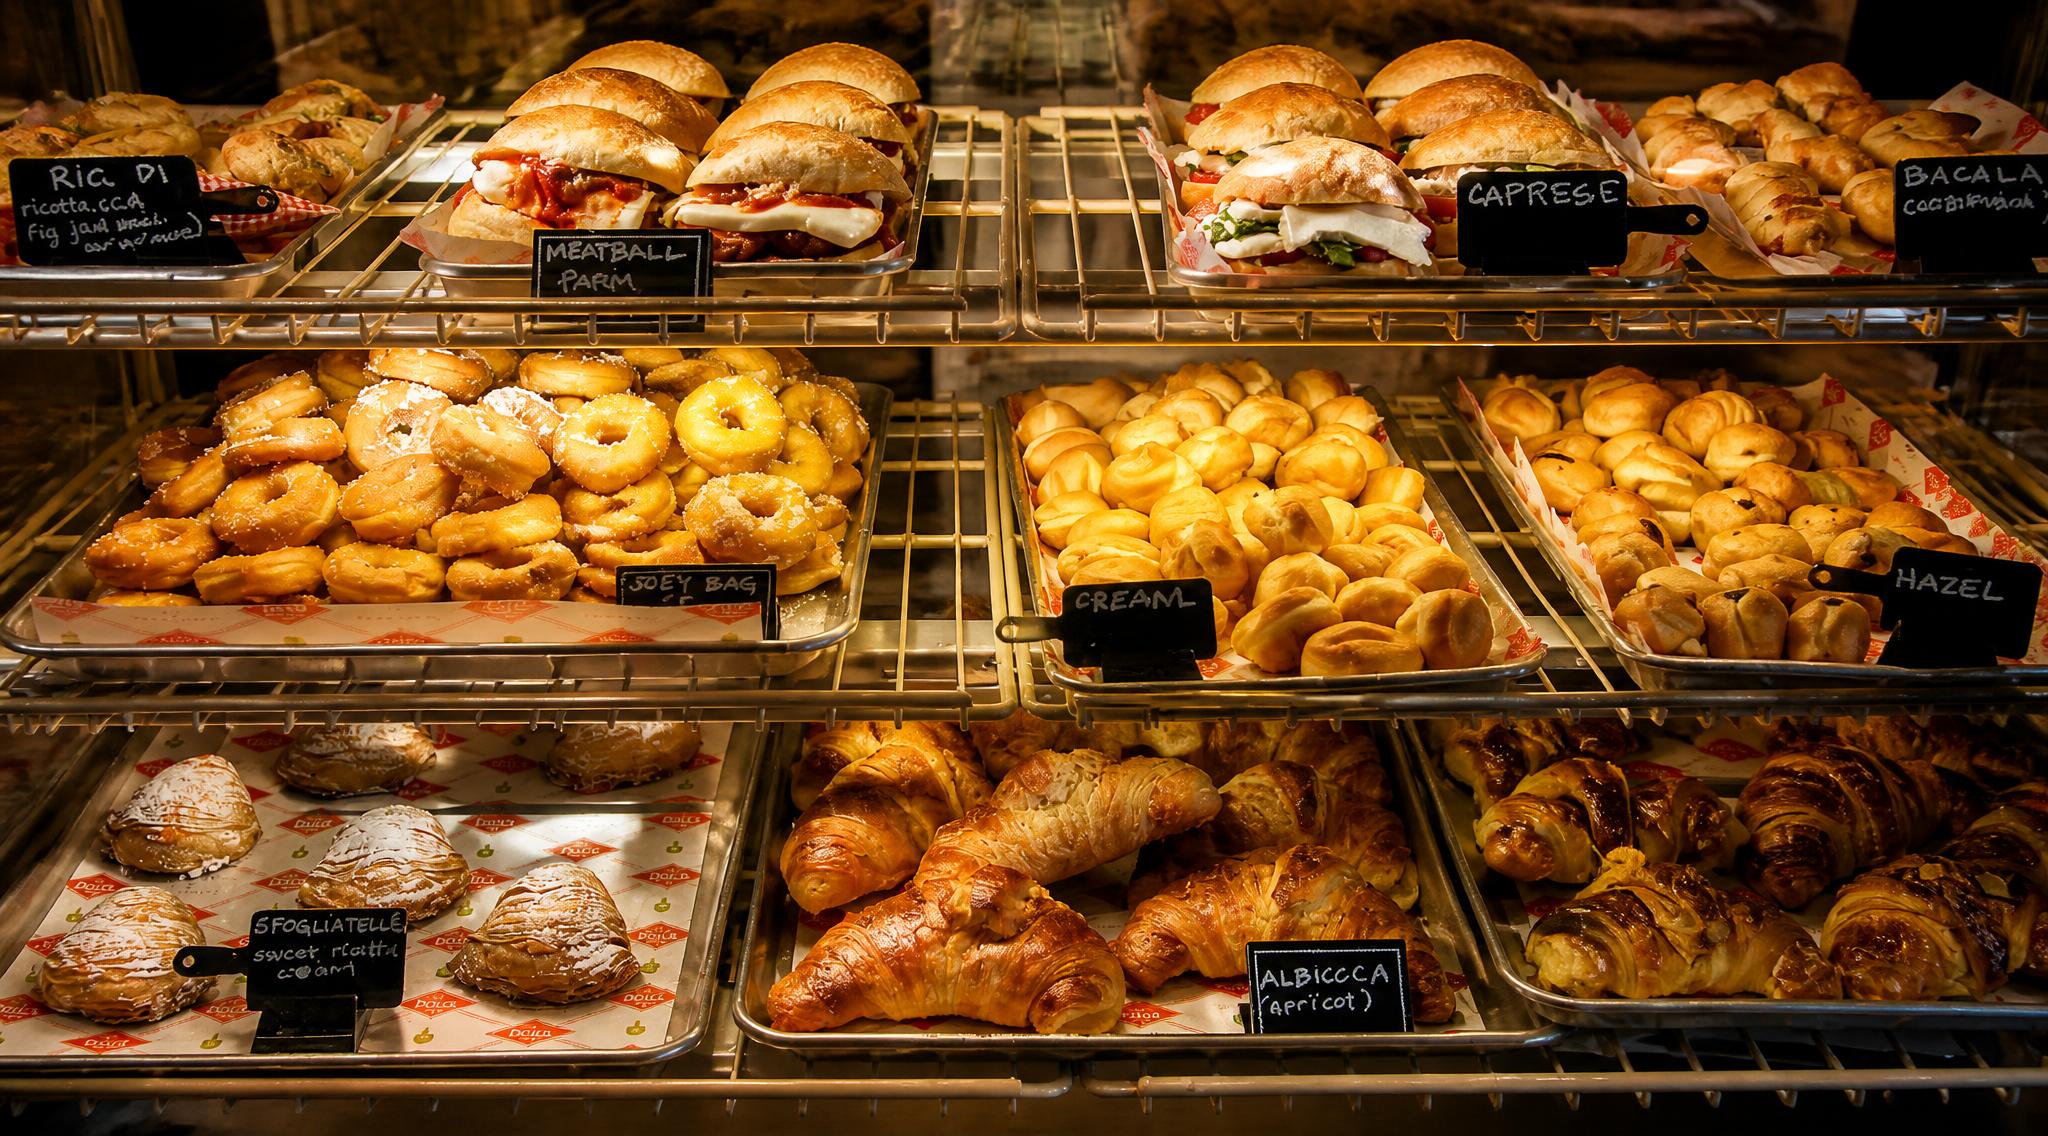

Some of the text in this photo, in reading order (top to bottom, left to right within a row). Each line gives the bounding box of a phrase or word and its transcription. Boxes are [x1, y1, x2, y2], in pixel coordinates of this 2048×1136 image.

[1903, 163, 2044, 188] BACALA
[1468, 179, 1620, 207] CAPRESE
[546, 240, 688, 264] MEATBALL
[557, 269, 638, 294] PARM
[705, 575, 757, 597] BAG
[1895, 567, 2005, 602] HAZEL
[1075, 586, 1197, 613] CREAM
